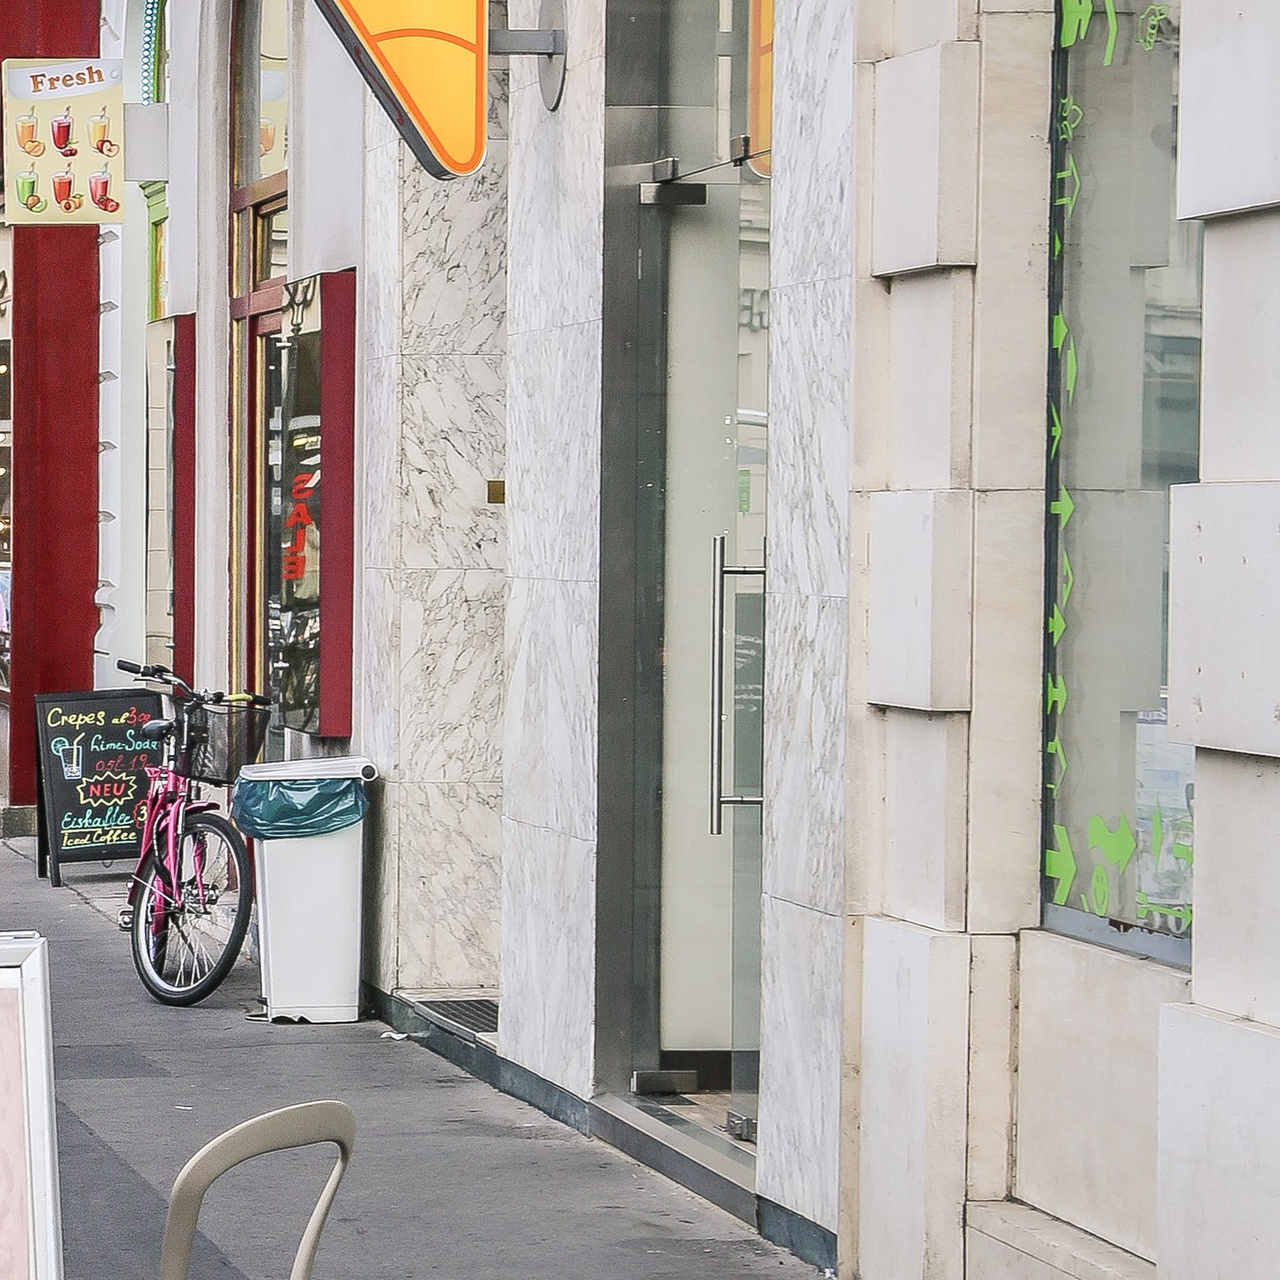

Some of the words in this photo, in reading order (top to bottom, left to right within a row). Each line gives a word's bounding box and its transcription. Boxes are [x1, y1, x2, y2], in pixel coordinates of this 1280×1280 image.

[29, 66, 105, 93] Fresh
[47, 707, 106, 731] Crepes
[89, 783, 126, 797] NEU
[62, 832, 91, 847] Iced
[93, 829, 138, 845] Coffee
